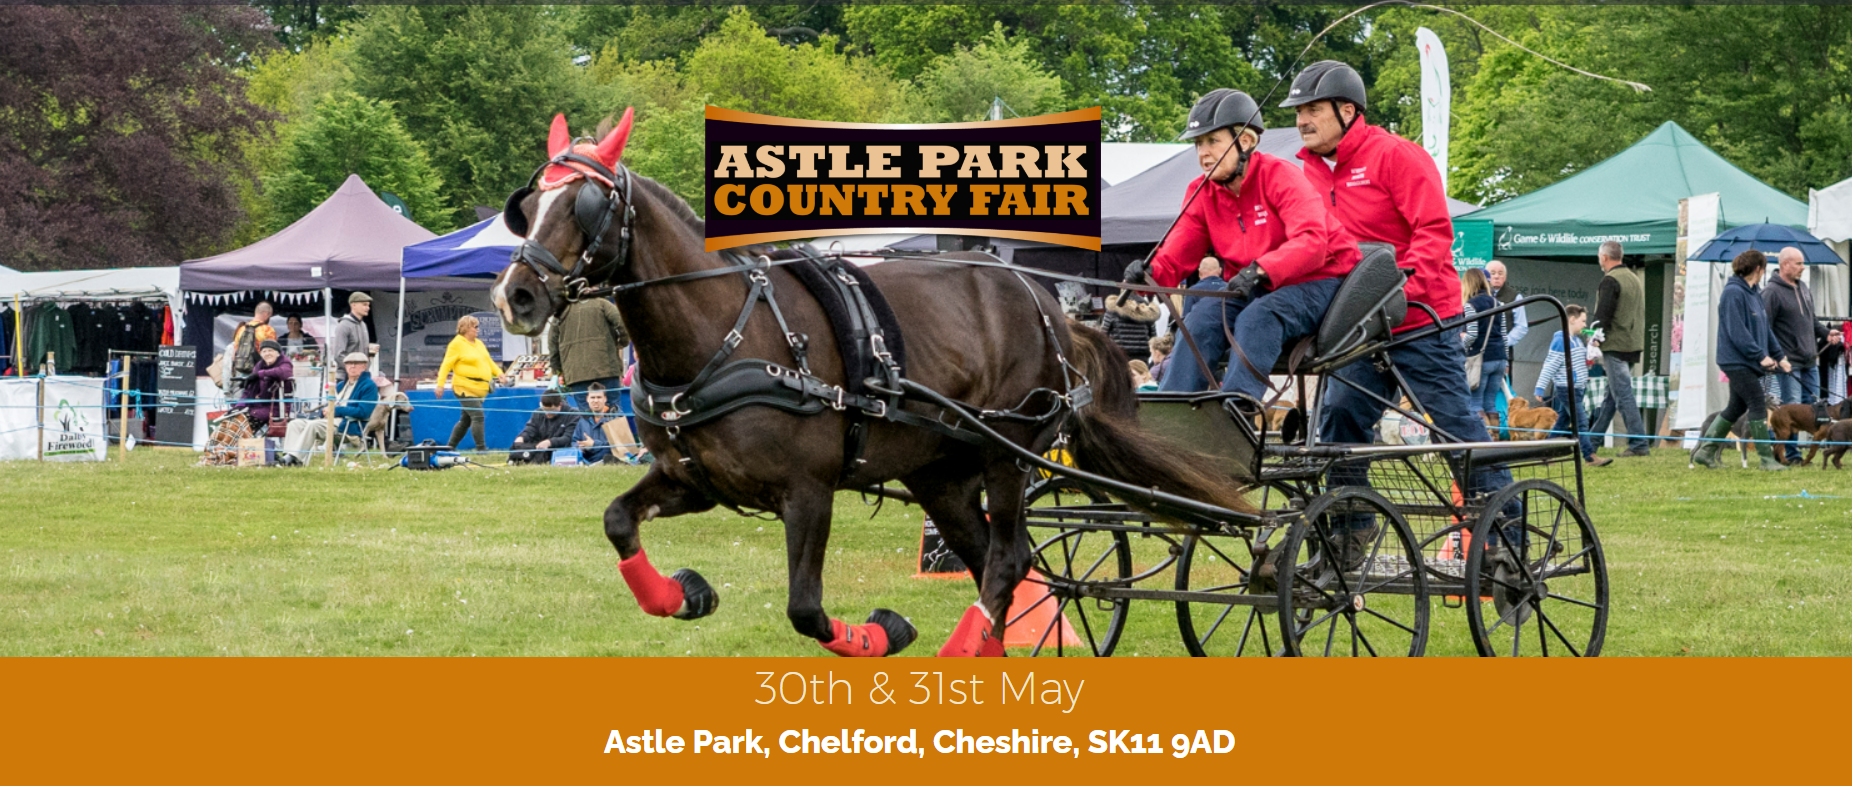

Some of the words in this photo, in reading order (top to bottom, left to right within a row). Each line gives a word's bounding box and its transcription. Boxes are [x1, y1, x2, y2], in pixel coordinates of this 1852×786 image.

[1513, 233, 1539, 244] Game
[1539, 234, 1547, 243] &
[1547, 232, 1579, 244] Wildlife
[1579, 234, 1629, 244] CONSERVATION
[1629, 233, 1651, 243] TRUST
[1458, 256, 1487, 266] Wildlife
[1567, 286, 1589, 301] today
[1647, 323, 1660, 373] esearch
